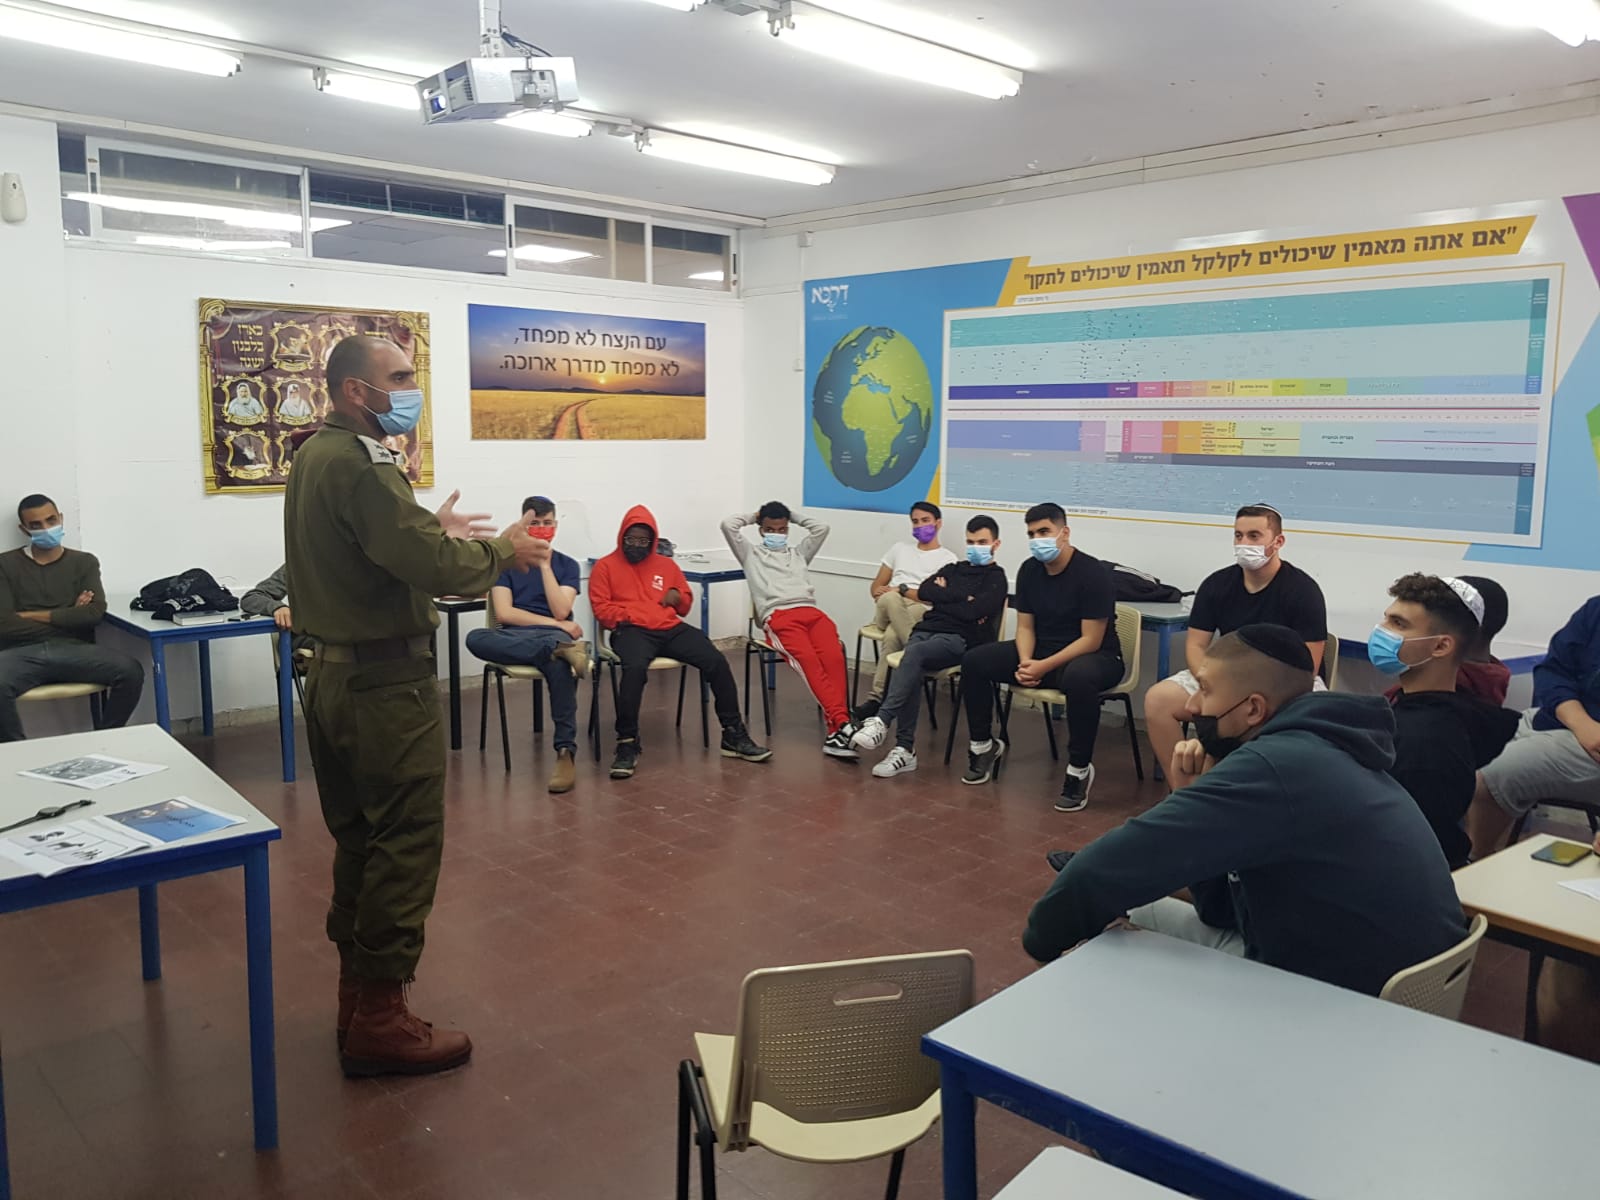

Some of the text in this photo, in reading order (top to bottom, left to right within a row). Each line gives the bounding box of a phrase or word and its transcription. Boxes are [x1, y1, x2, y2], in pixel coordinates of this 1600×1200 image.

[1413, 232, 1464, 252] אתה
[1471, 226, 1518, 247] "אם
[1259, 243, 1337, 266] שיכולים
[1343, 237, 1406, 262] מאמין
[1136, 258, 1186, 280] תאמין
[1191, 248, 1252, 274] לקלקל
[1070, 264, 1131, 283] שיכולים
[231, 337, 265, 354] בלבנון
[513, 327, 667, 351] עם הנצח לא מפחד,
[499, 353, 681, 377] לא מפחד מדרך ארוכה.
